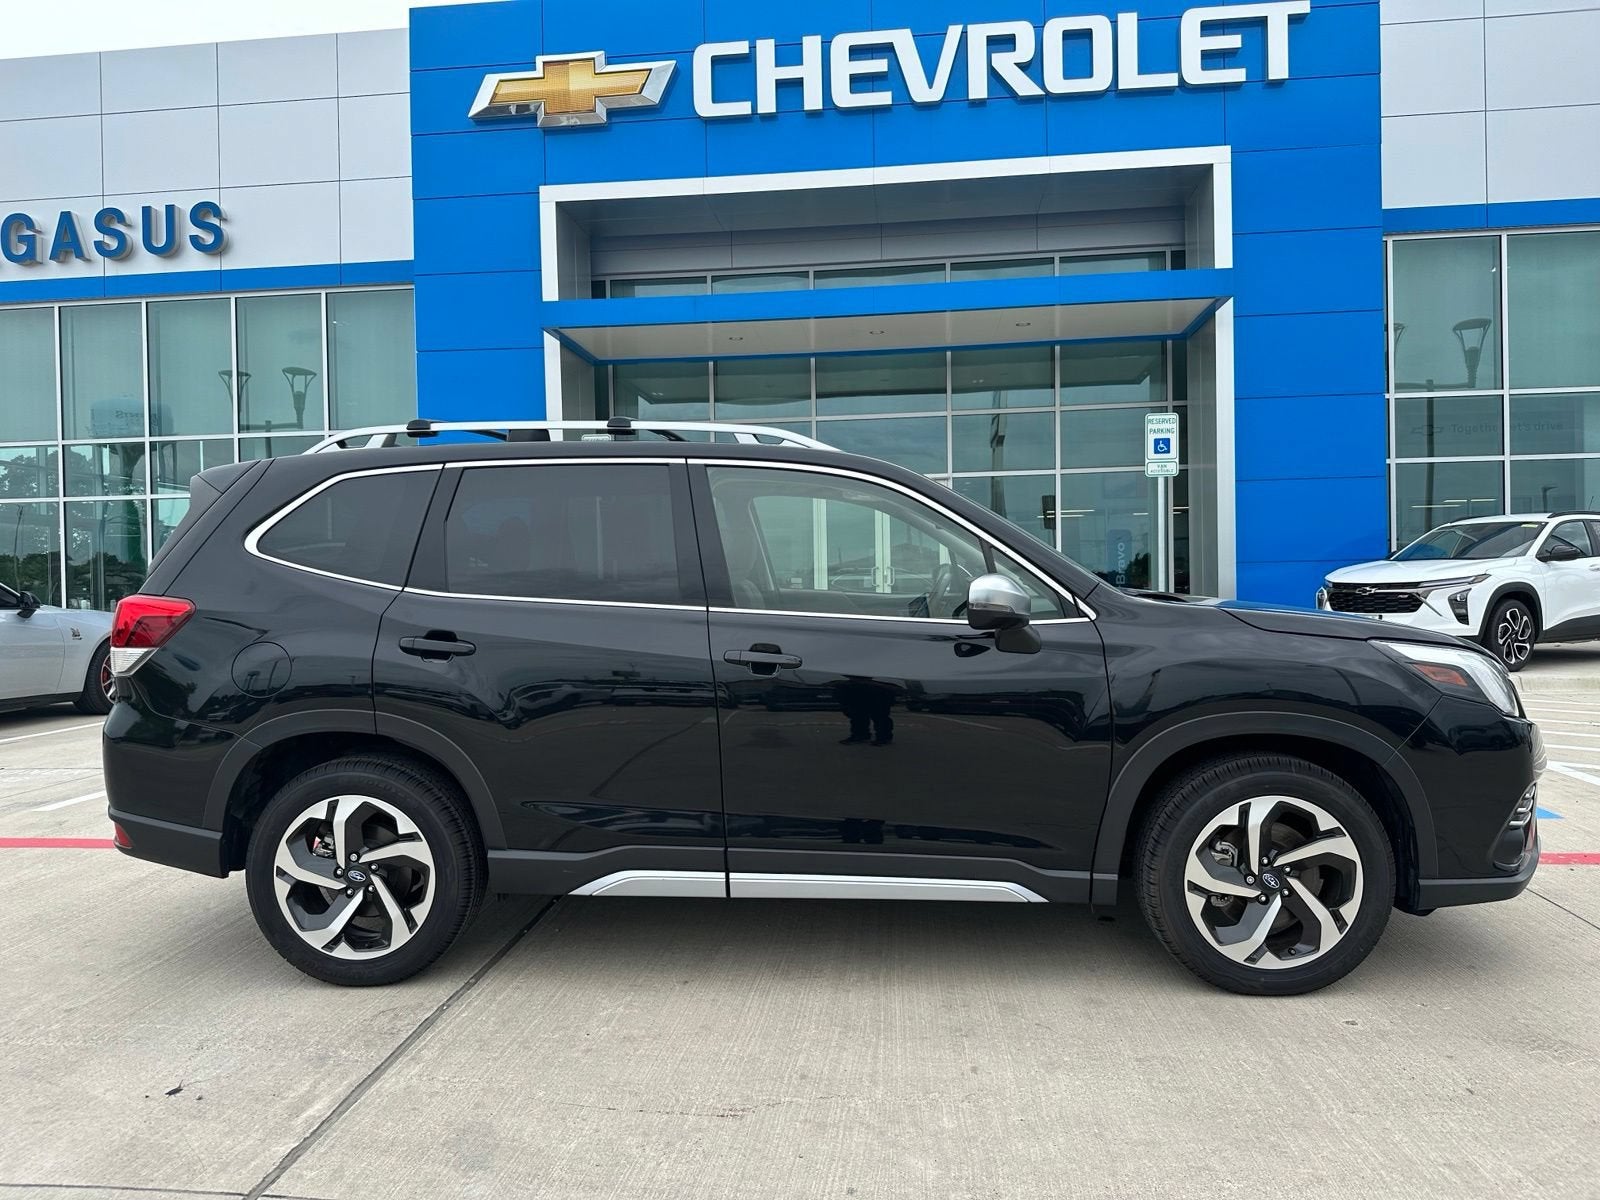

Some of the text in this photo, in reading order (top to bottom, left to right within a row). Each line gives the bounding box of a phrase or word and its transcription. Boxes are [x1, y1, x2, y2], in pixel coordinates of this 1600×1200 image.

[692, 1, 1311, 119] CHEVROLET
[0, 201, 226, 264] GASUS
[1115, 542, 1126, 585] Bravo
